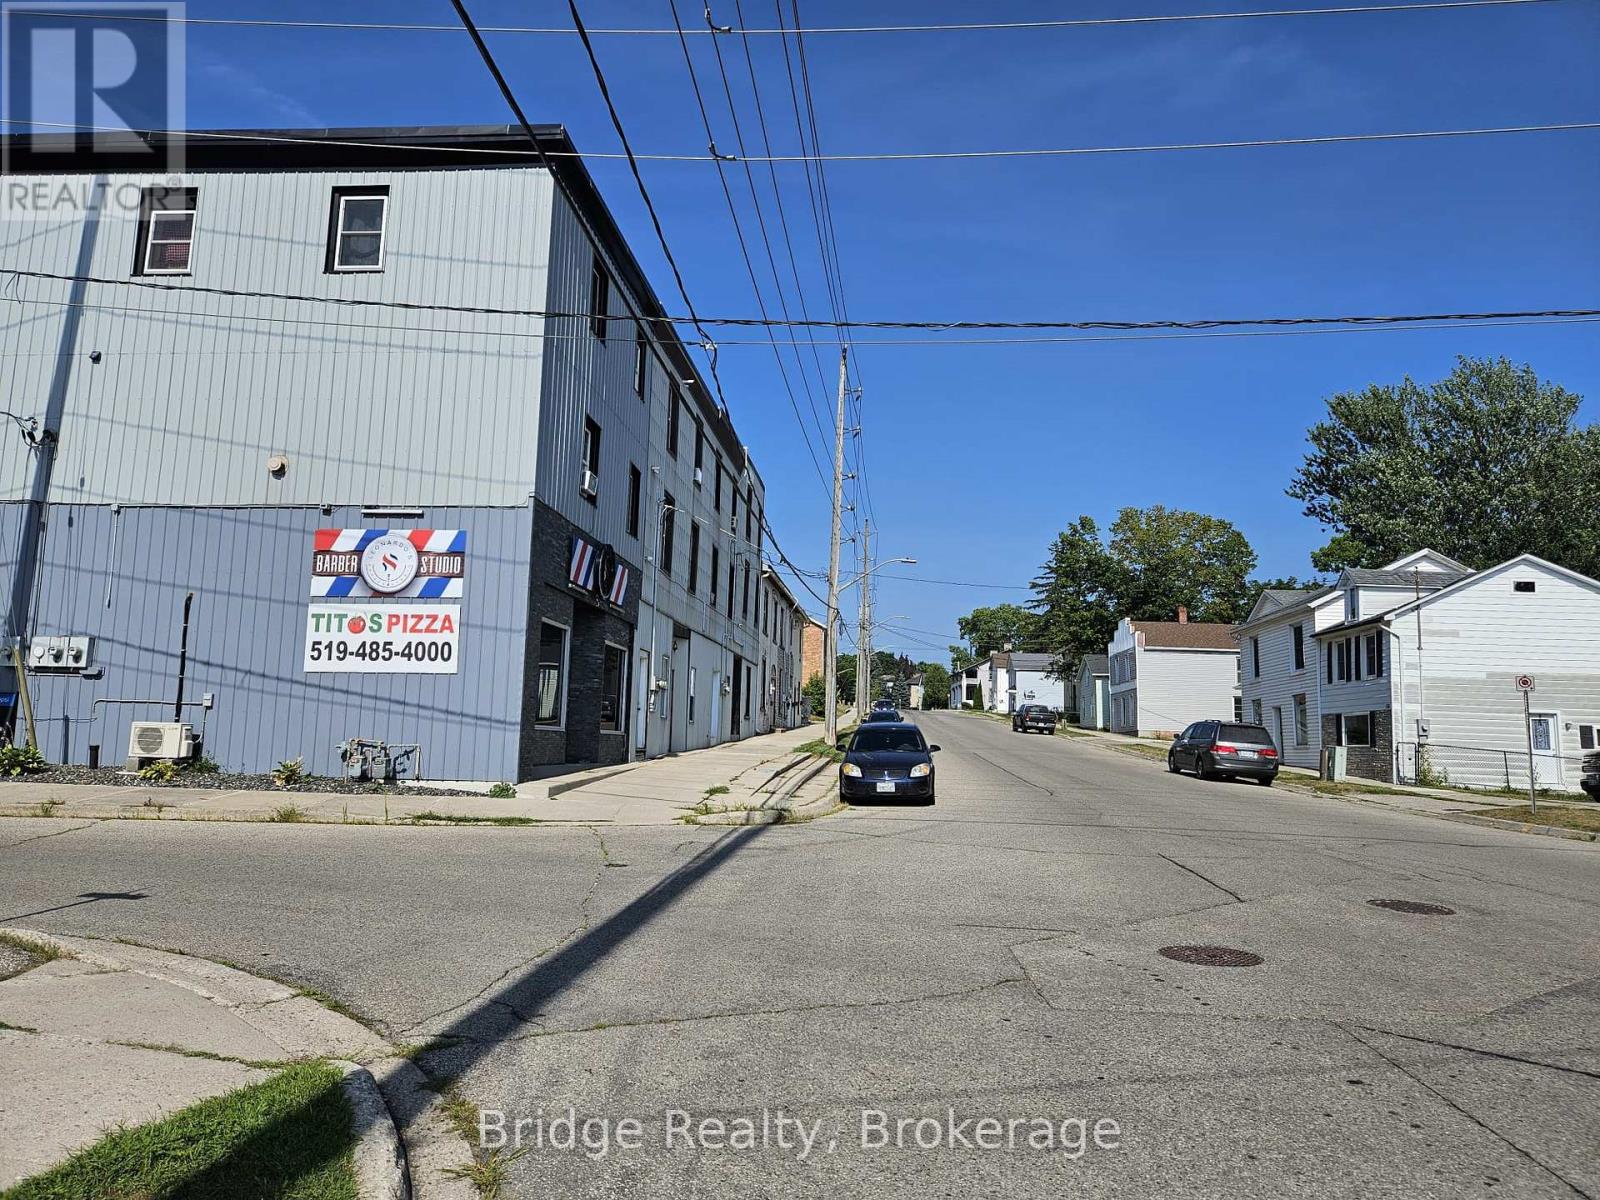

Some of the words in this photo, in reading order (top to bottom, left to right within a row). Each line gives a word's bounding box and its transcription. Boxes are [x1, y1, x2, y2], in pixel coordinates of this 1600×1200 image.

[315, 554, 358, 573] BARBER
[420, 556, 461, 574] STUDIO
[386, 614, 455, 634] PIZZA
[309, 640, 452, 662] 519-485-4000
